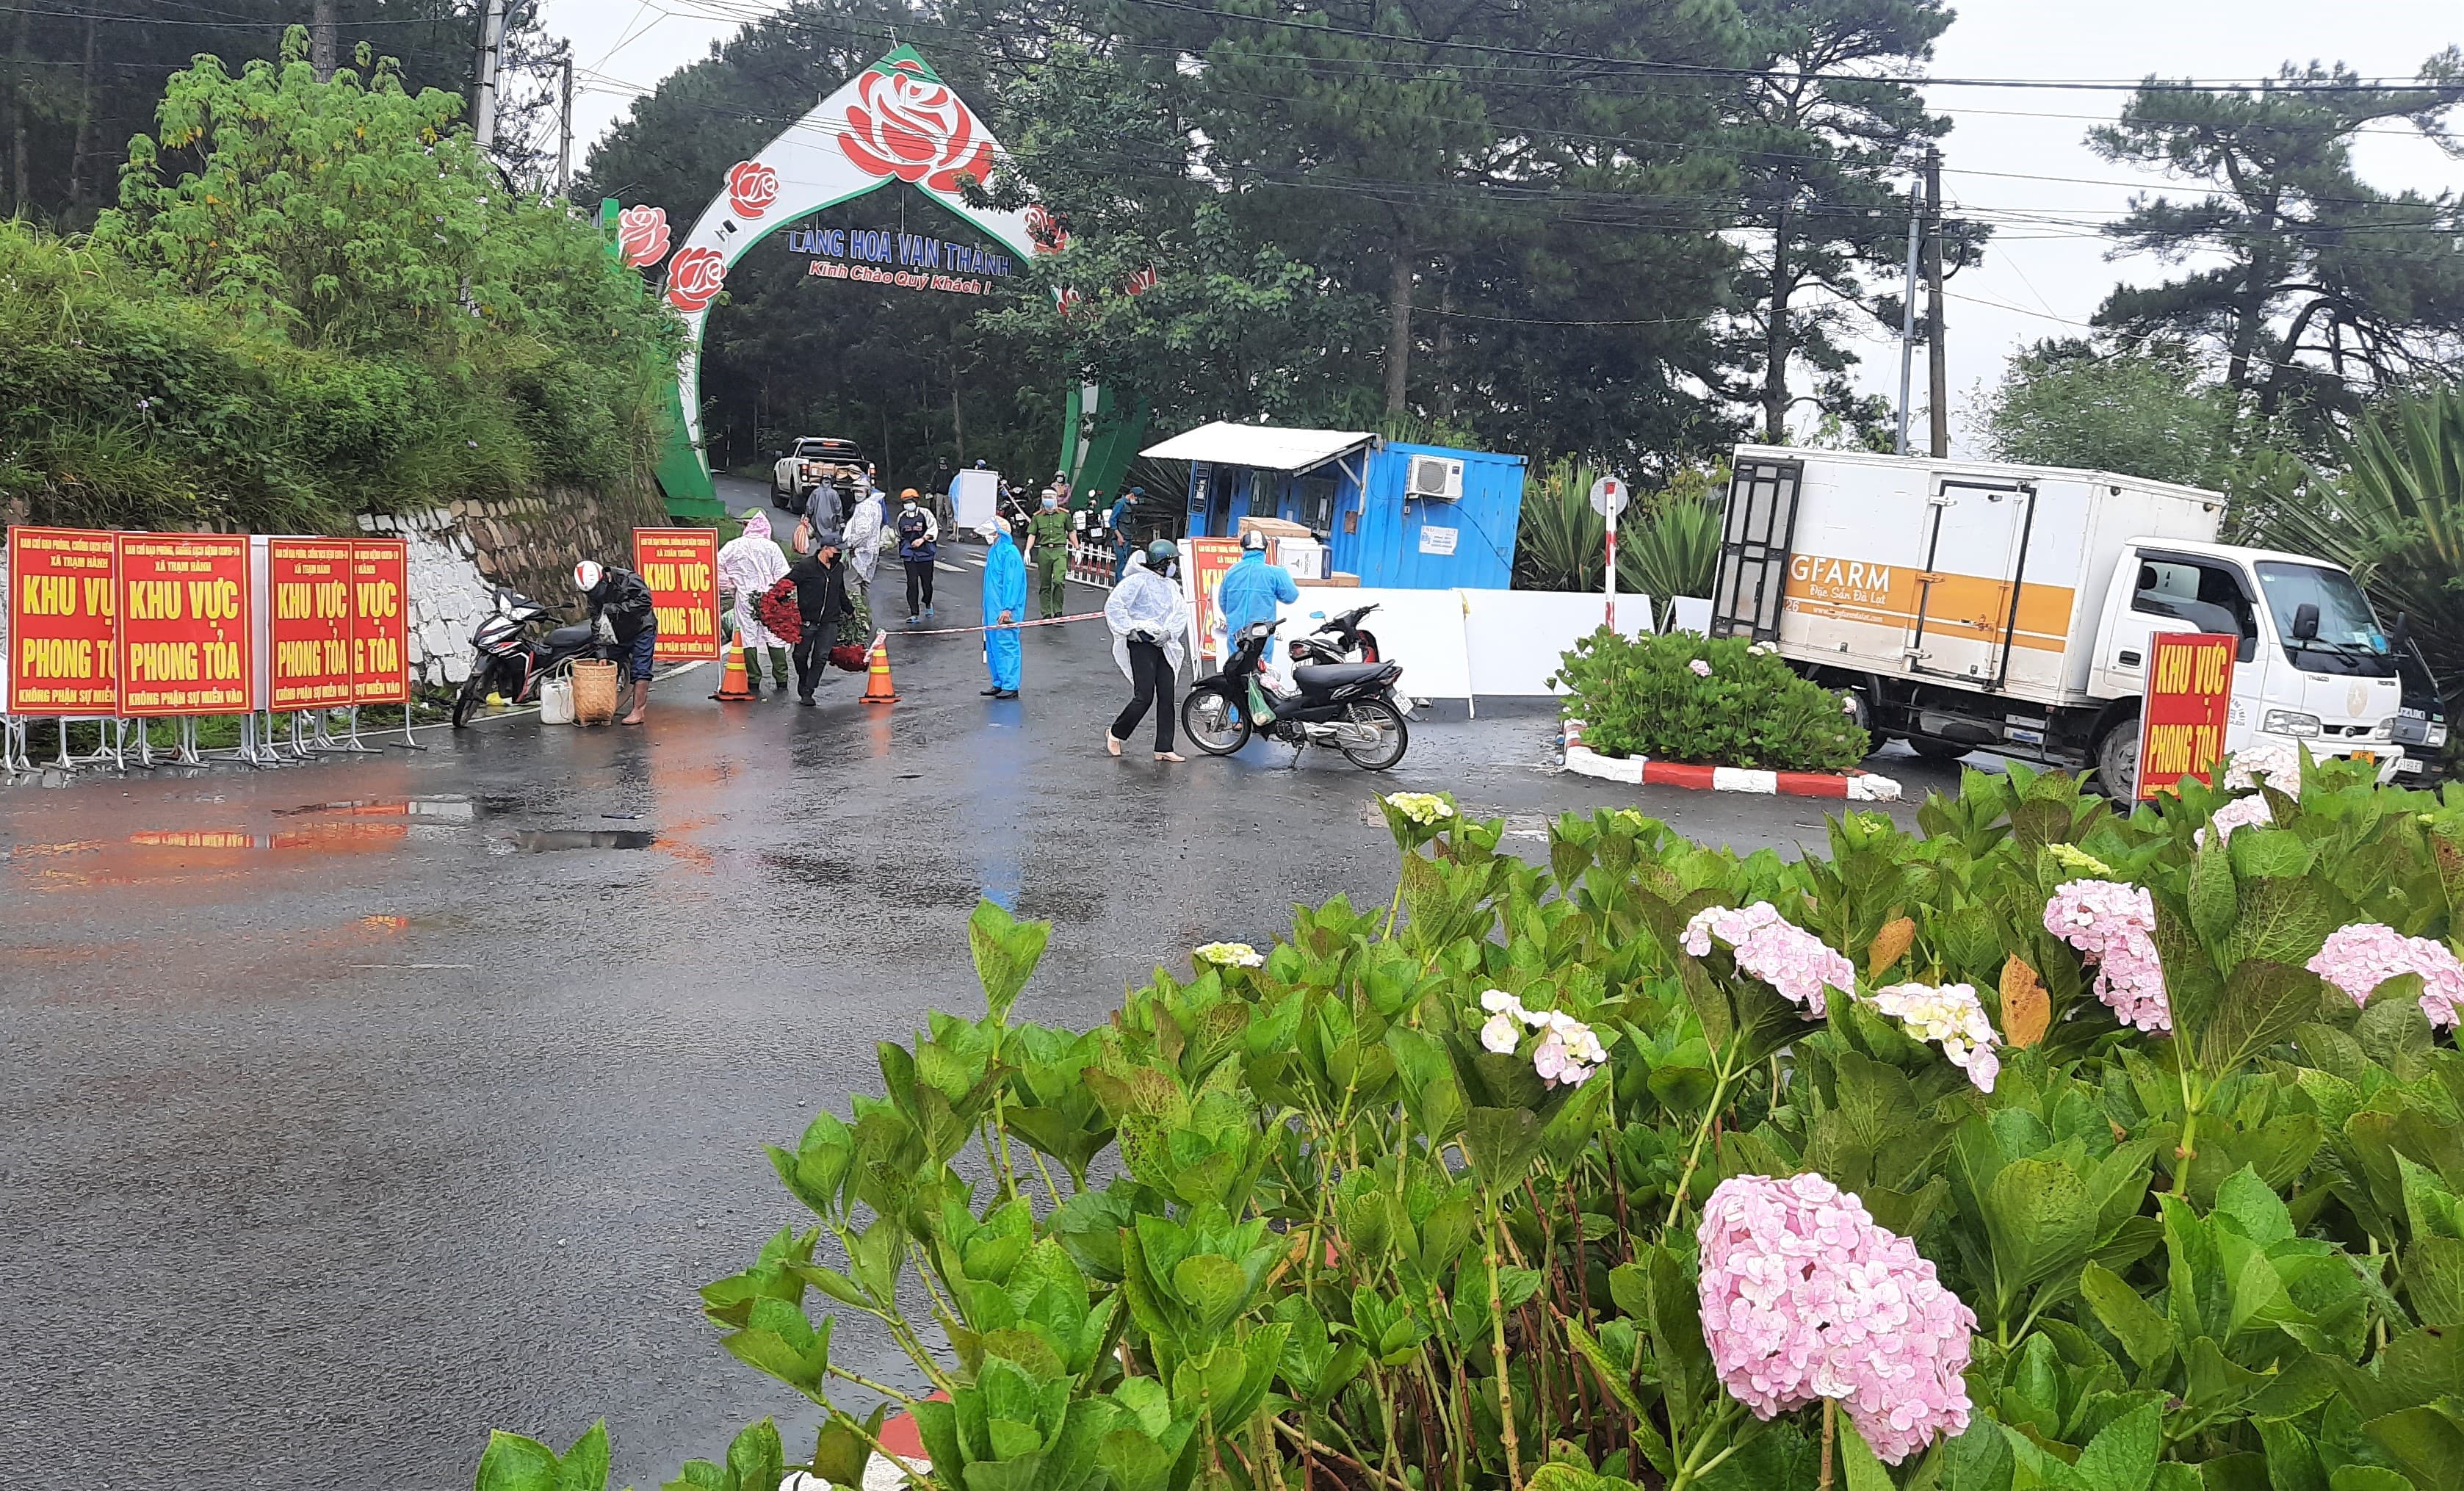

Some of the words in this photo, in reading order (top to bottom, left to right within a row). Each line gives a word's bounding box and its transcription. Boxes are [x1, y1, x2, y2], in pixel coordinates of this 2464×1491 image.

[790, 220, 845, 257] LÀNG
[850, 230, 892, 263] HOA
[898, 233, 939, 273] VẠN
[944, 241, 1012, 277] THÀNH
[850, 265, 894, 284] Chào
[930, 275, 982, 294] Khách
[23, 575, 76, 615] KHU
[643, 563, 675, 591] KHU
[679, 561, 710, 598] VỰC
[1791, 555, 1890, 593] GFARM
[1810, 584, 1828, 599] Đặc
[1830, 586, 1851, 600] Sản
[1853, 589, 1868, 602] Đà
[1871, 592, 1886, 606] Lạt
[129, 581, 181, 620] KHU
[188, 577, 239, 628] VỰC
[278, 582, 311, 619] KHU
[315, 579, 347, 627] VỰC
[356, 579, 397, 626] VỰC
[654, 607, 687, 635] HONG
[689, 598, 712, 635] TỎA
[22, 638, 92, 679] PHONG
[130, 642, 198, 682] PHONG
[203, 629, 241, 679] TỎA
[278, 640, 322, 678] PHONG
[324, 627, 347, 675] TỎA
[368, 627, 398, 673] TỎA
[2156, 645, 2193, 695] KHU
[2194, 641, 2228, 706] VỰC
[18, 687, 50, 702] KHÔNG
[51, 687, 77, 705] PHẬN
[79, 688, 93, 705] SỰ
[128, 690, 159, 706] KHÔNG
[187, 690, 200, 707] SỰ
[225, 688, 243, 703] VÀO
[2147, 724, 2193, 773] PHONG
[2194, 708, 2219, 773] TỎA
